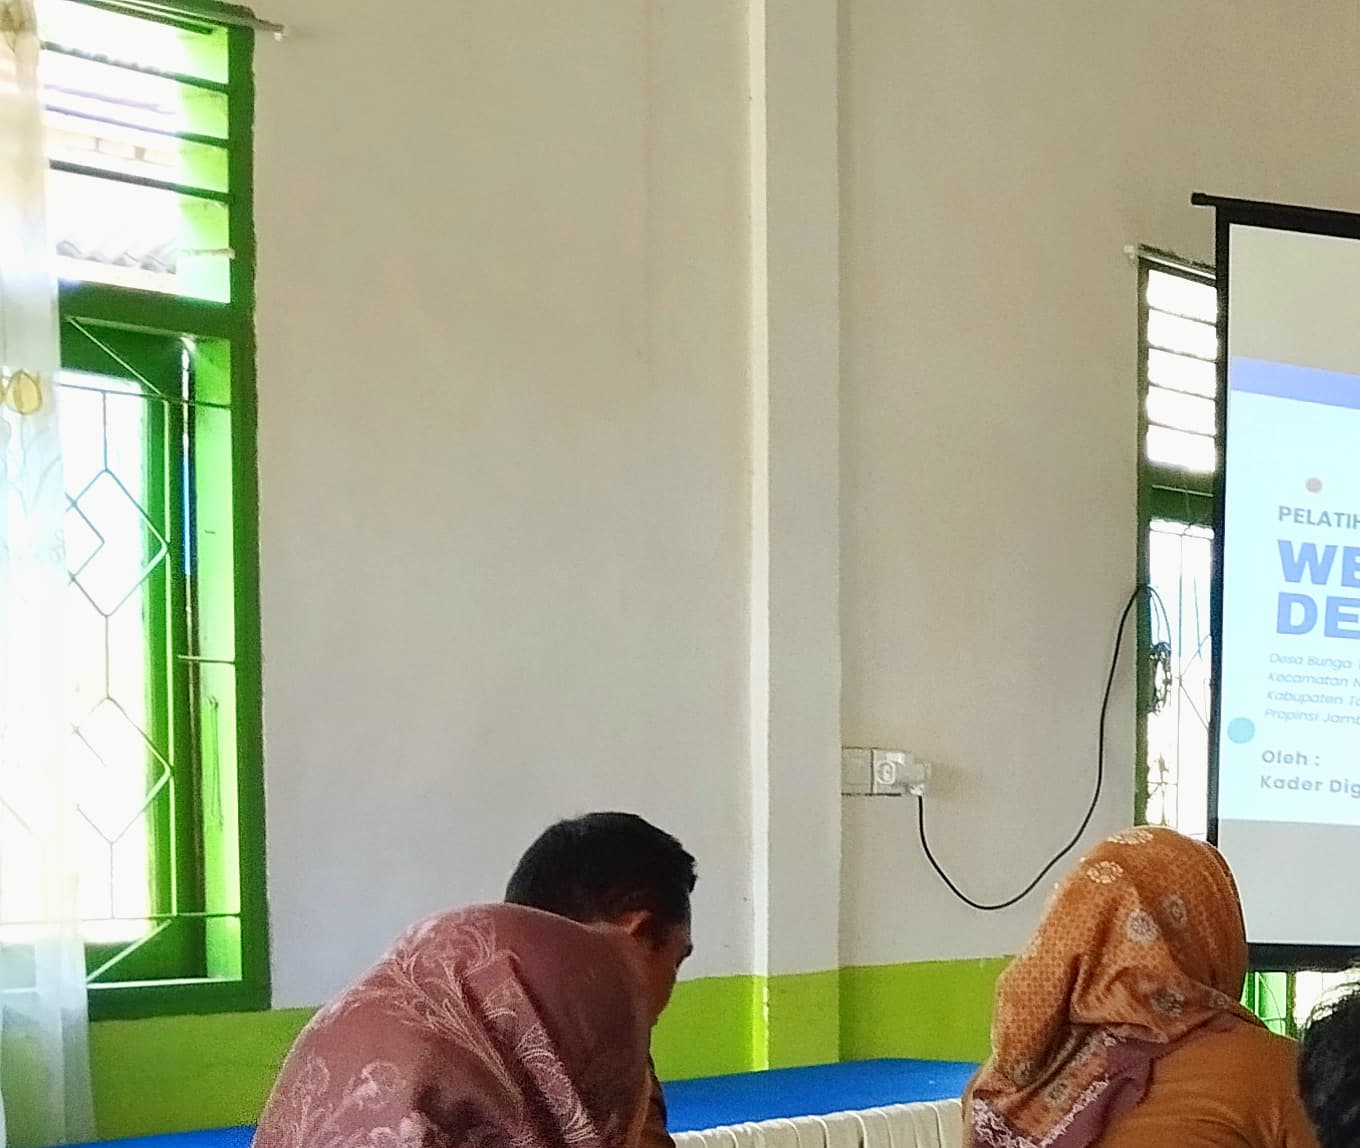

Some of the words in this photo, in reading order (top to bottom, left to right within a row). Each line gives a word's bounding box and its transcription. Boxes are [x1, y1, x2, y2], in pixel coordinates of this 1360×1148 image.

[1269, 652, 1304, 666] Desa
[1307, 655, 1352, 670] Bunga
[1268, 671, 1349, 688] Kecamatan
[1266, 690, 1343, 707] Kabupaten
[1261, 749, 1308, 767] Oleh
[1260, 774, 1323, 793] Kader
